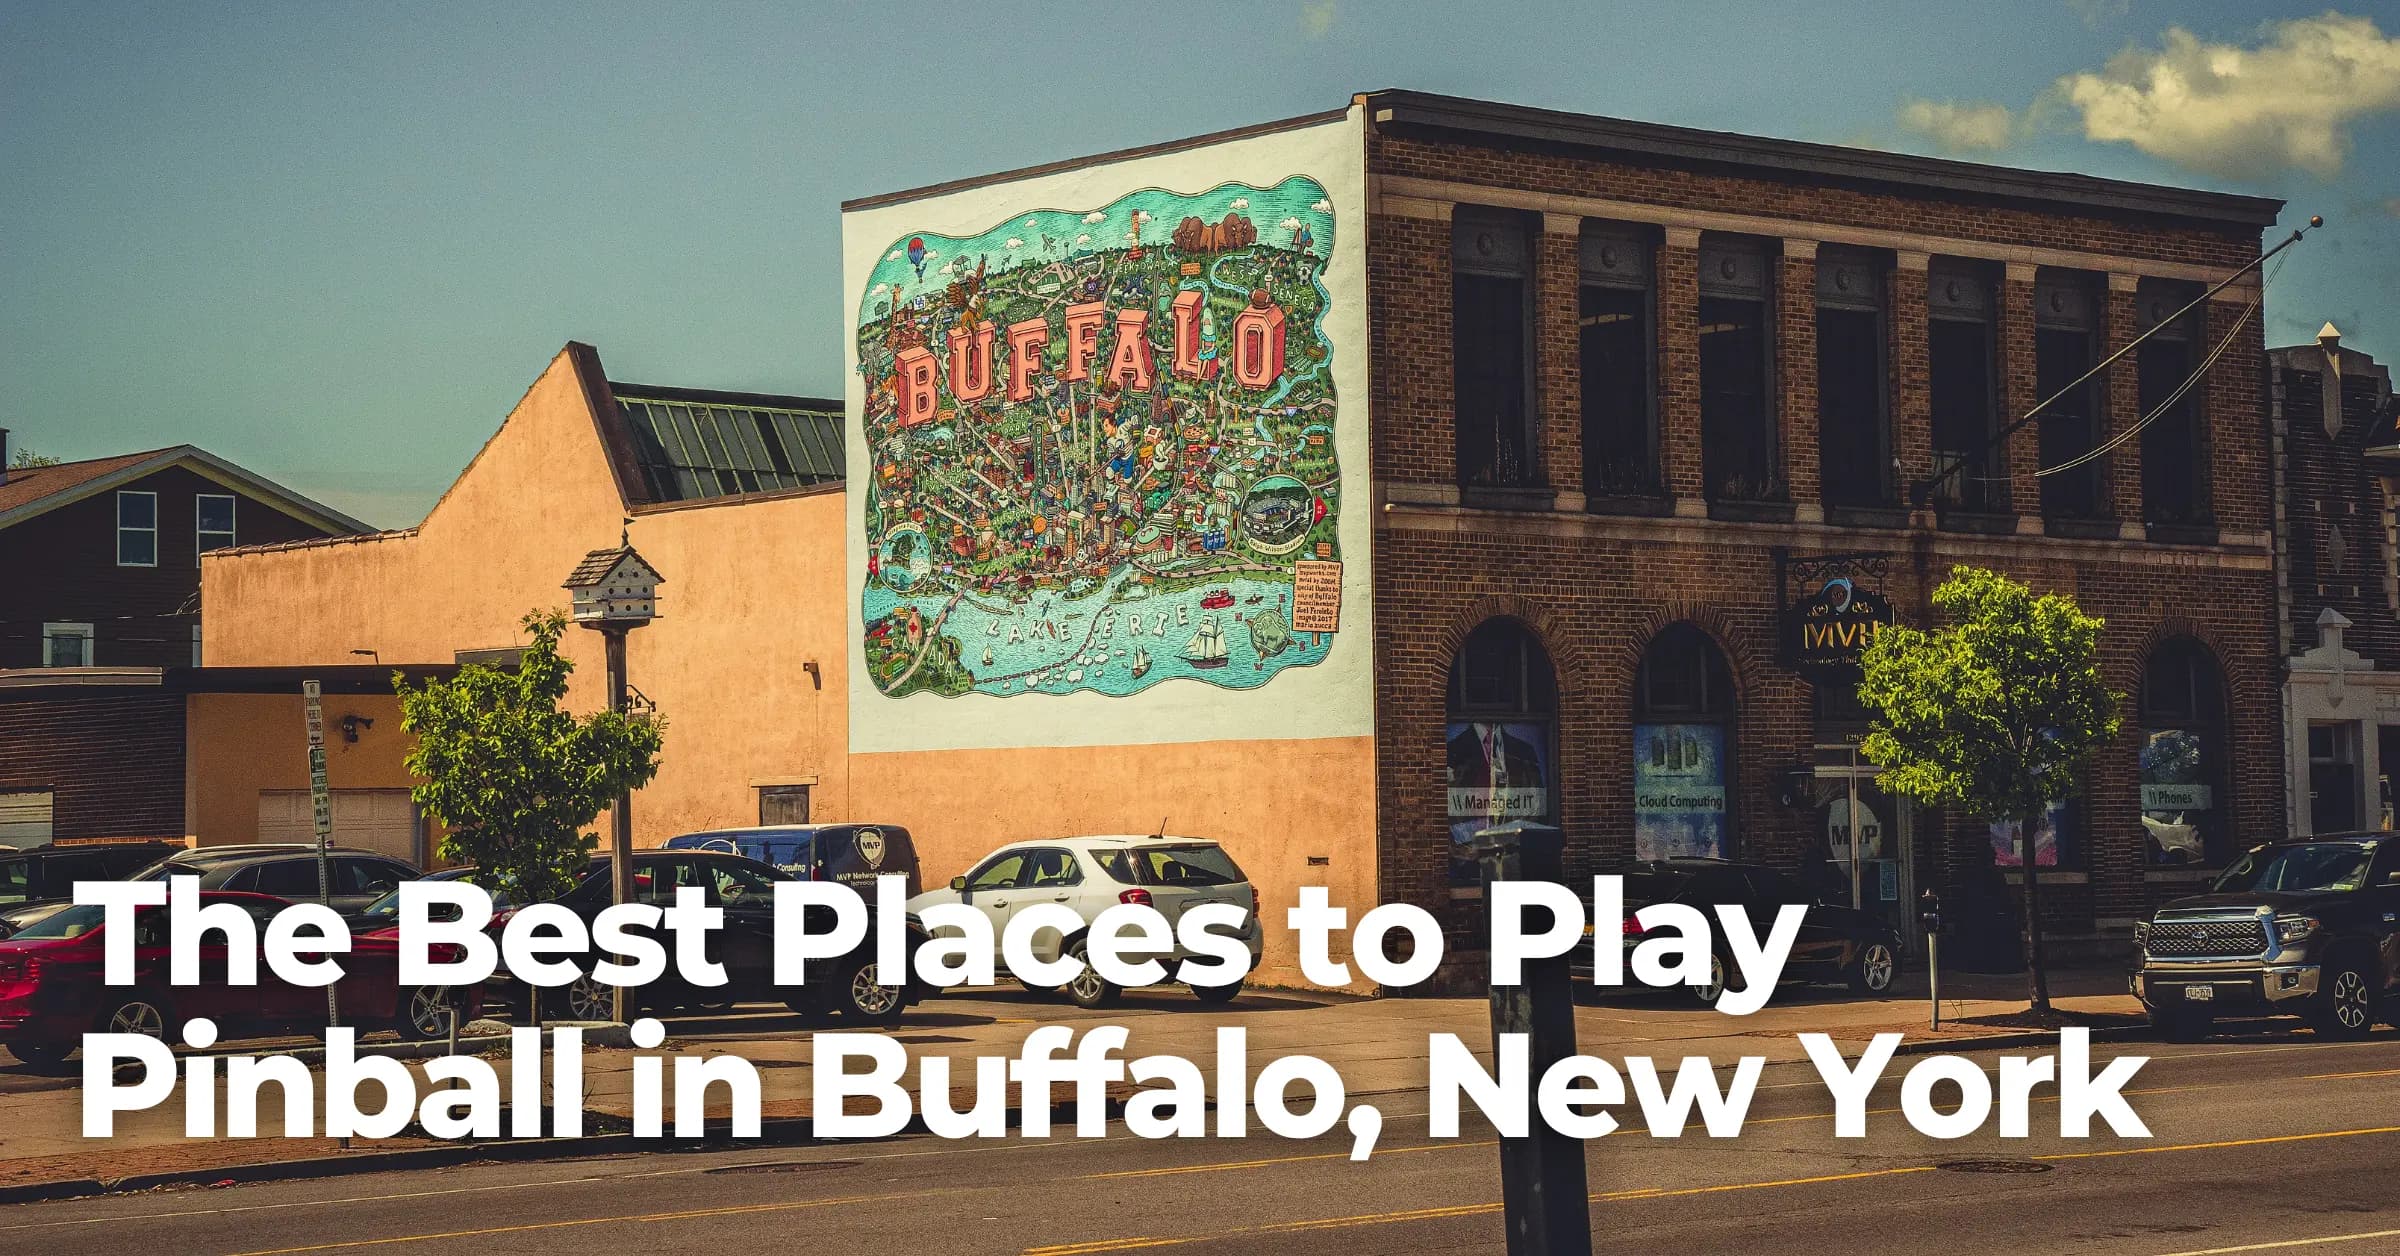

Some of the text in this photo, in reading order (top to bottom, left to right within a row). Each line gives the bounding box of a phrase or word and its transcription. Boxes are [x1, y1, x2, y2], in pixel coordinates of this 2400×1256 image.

[1272, 283, 1314, 312] SENECA
[895, 290, 1286, 429] BUFFALO
[985, 603, 1189, 644] LAKE ERIE
[1465, 795, 1521, 815] Managed
[1523, 795, 1534, 809] IT
[1638, 795, 1723, 811] Cloud Computing
[2157, 790, 2193, 805] Phones
[862, 841, 881, 850] MVP
[836, 872, 852, 881] MVP
[853, 871, 878, 880] Network
